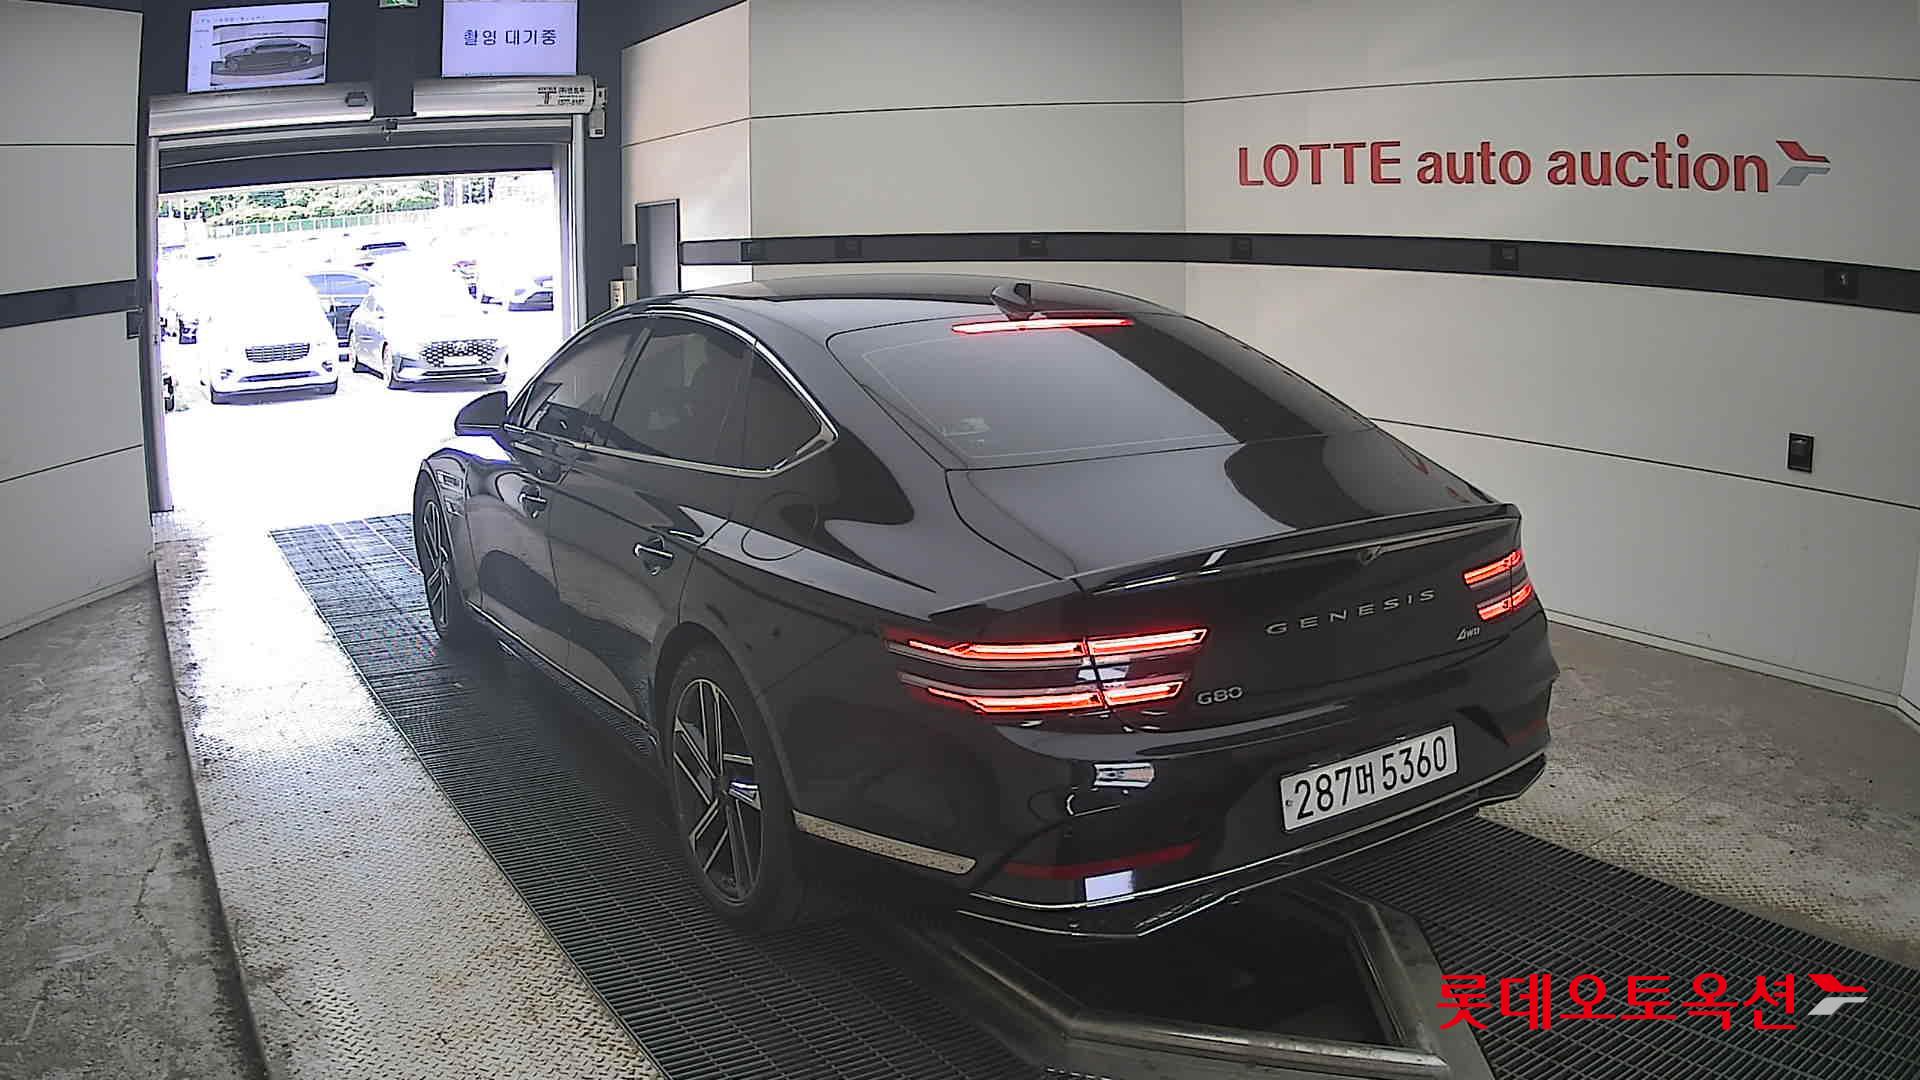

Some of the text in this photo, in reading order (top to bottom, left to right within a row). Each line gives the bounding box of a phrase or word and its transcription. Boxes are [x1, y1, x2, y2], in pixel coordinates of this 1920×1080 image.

[505, 29, 557, 46] 대기중
[1238, 133, 1769, 193] LOTTE auto auction
[1265, 589, 1436, 635] GENESIS
[1198, 686, 1243, 705] G80
[1382, 736, 1448, 791] 5360
